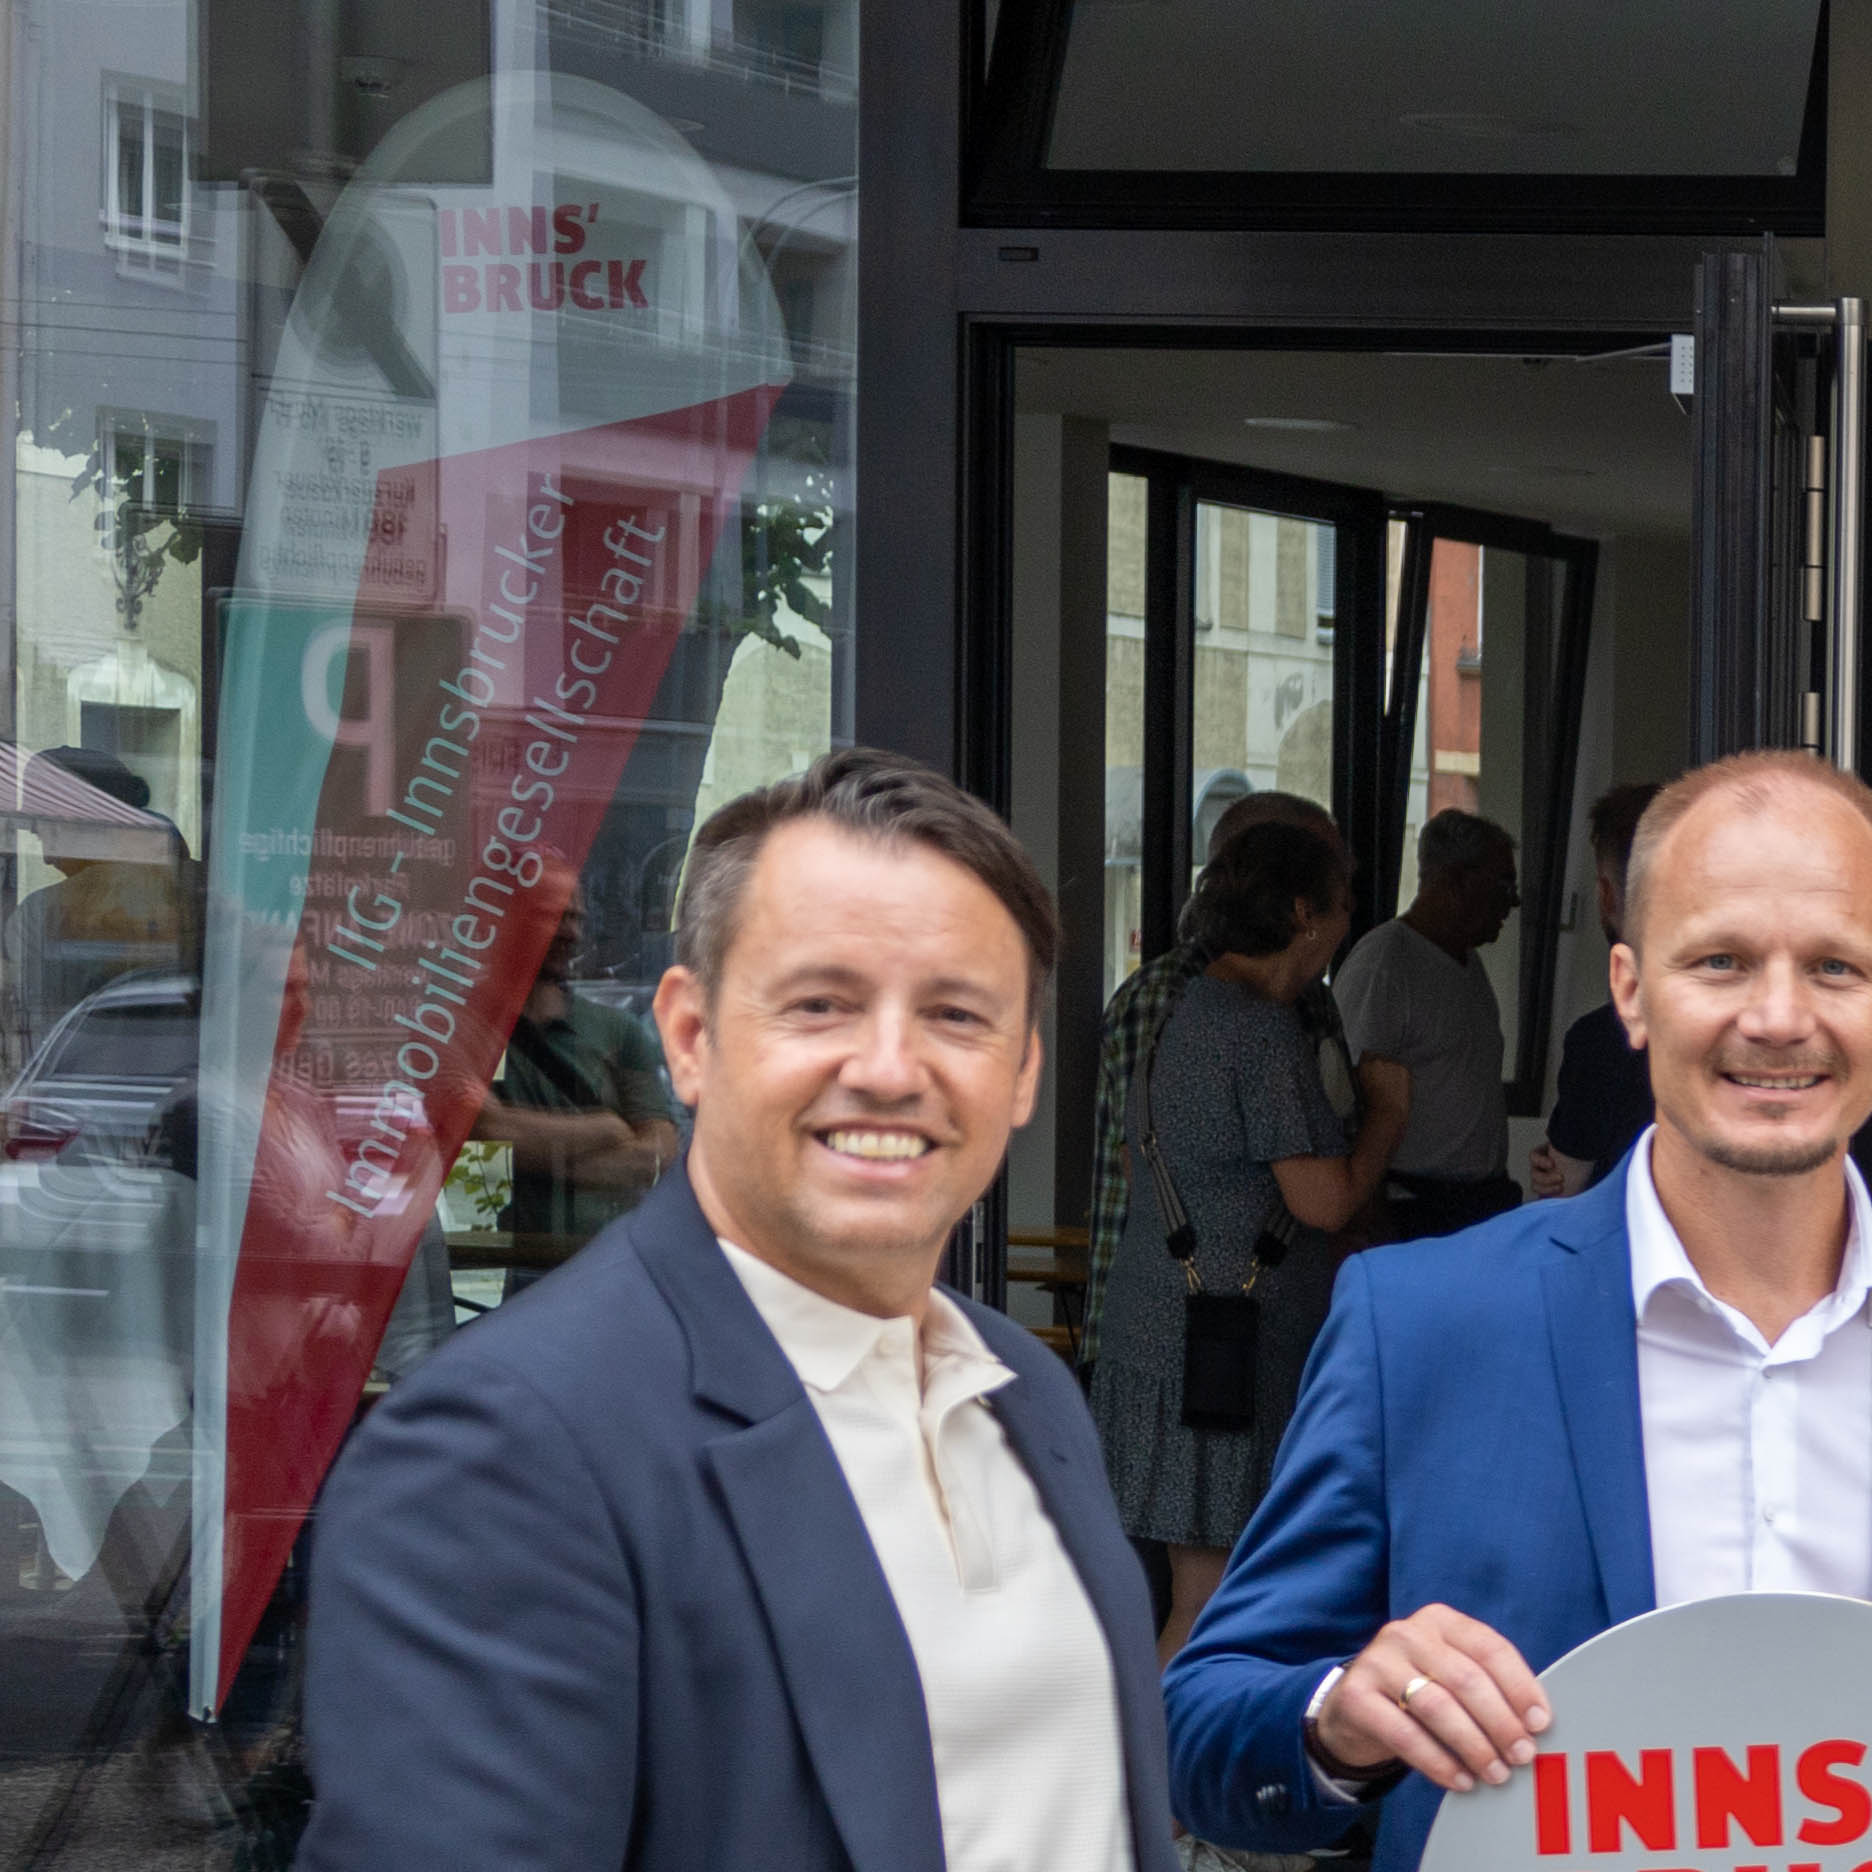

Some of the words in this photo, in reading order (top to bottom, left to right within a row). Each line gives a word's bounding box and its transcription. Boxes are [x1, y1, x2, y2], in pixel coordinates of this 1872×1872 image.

[441, 203, 600, 258] INNS'
[441, 259, 648, 315] BRUCK
[328, 883, 402, 971] IIG
[386, 474, 577, 837] Innsbrucker
[326, 513, 665, 1220] Immobiliengesellschaft
